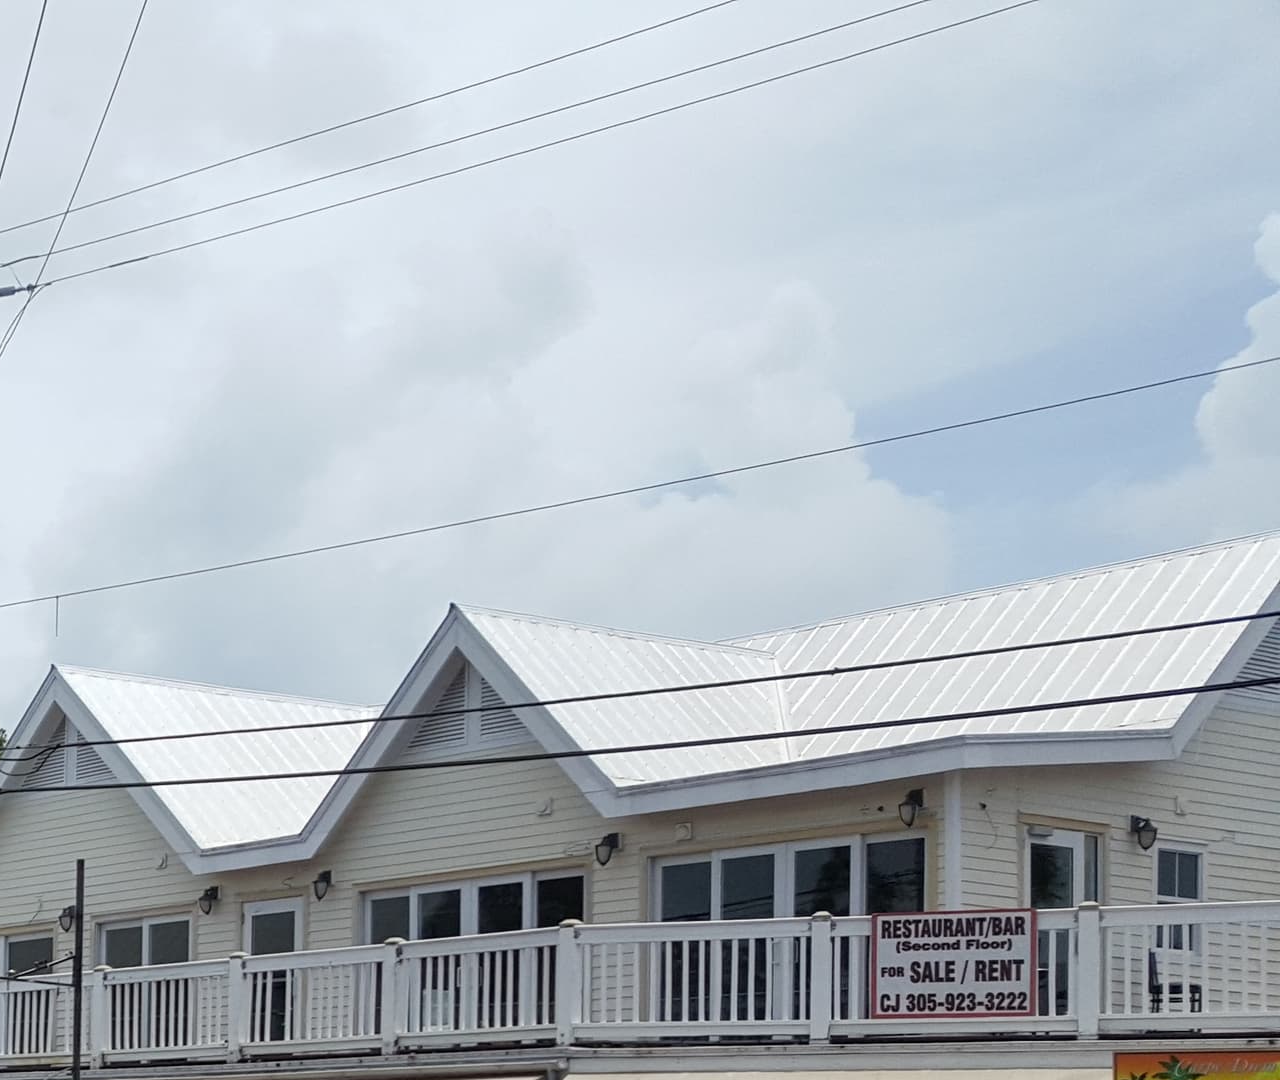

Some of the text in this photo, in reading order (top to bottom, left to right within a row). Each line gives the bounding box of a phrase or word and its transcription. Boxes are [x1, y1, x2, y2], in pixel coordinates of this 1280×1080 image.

[881, 916, 1026, 939] RESTAURANT/BAR
[896, 938, 1013, 953] (Second Floor)
[881, 967, 905, 977] FOR
[910, 961, 956, 983] SALE
[974, 959, 1025, 982] RENT
[880, 992, 1028, 1012] CJ 305-923-3222
